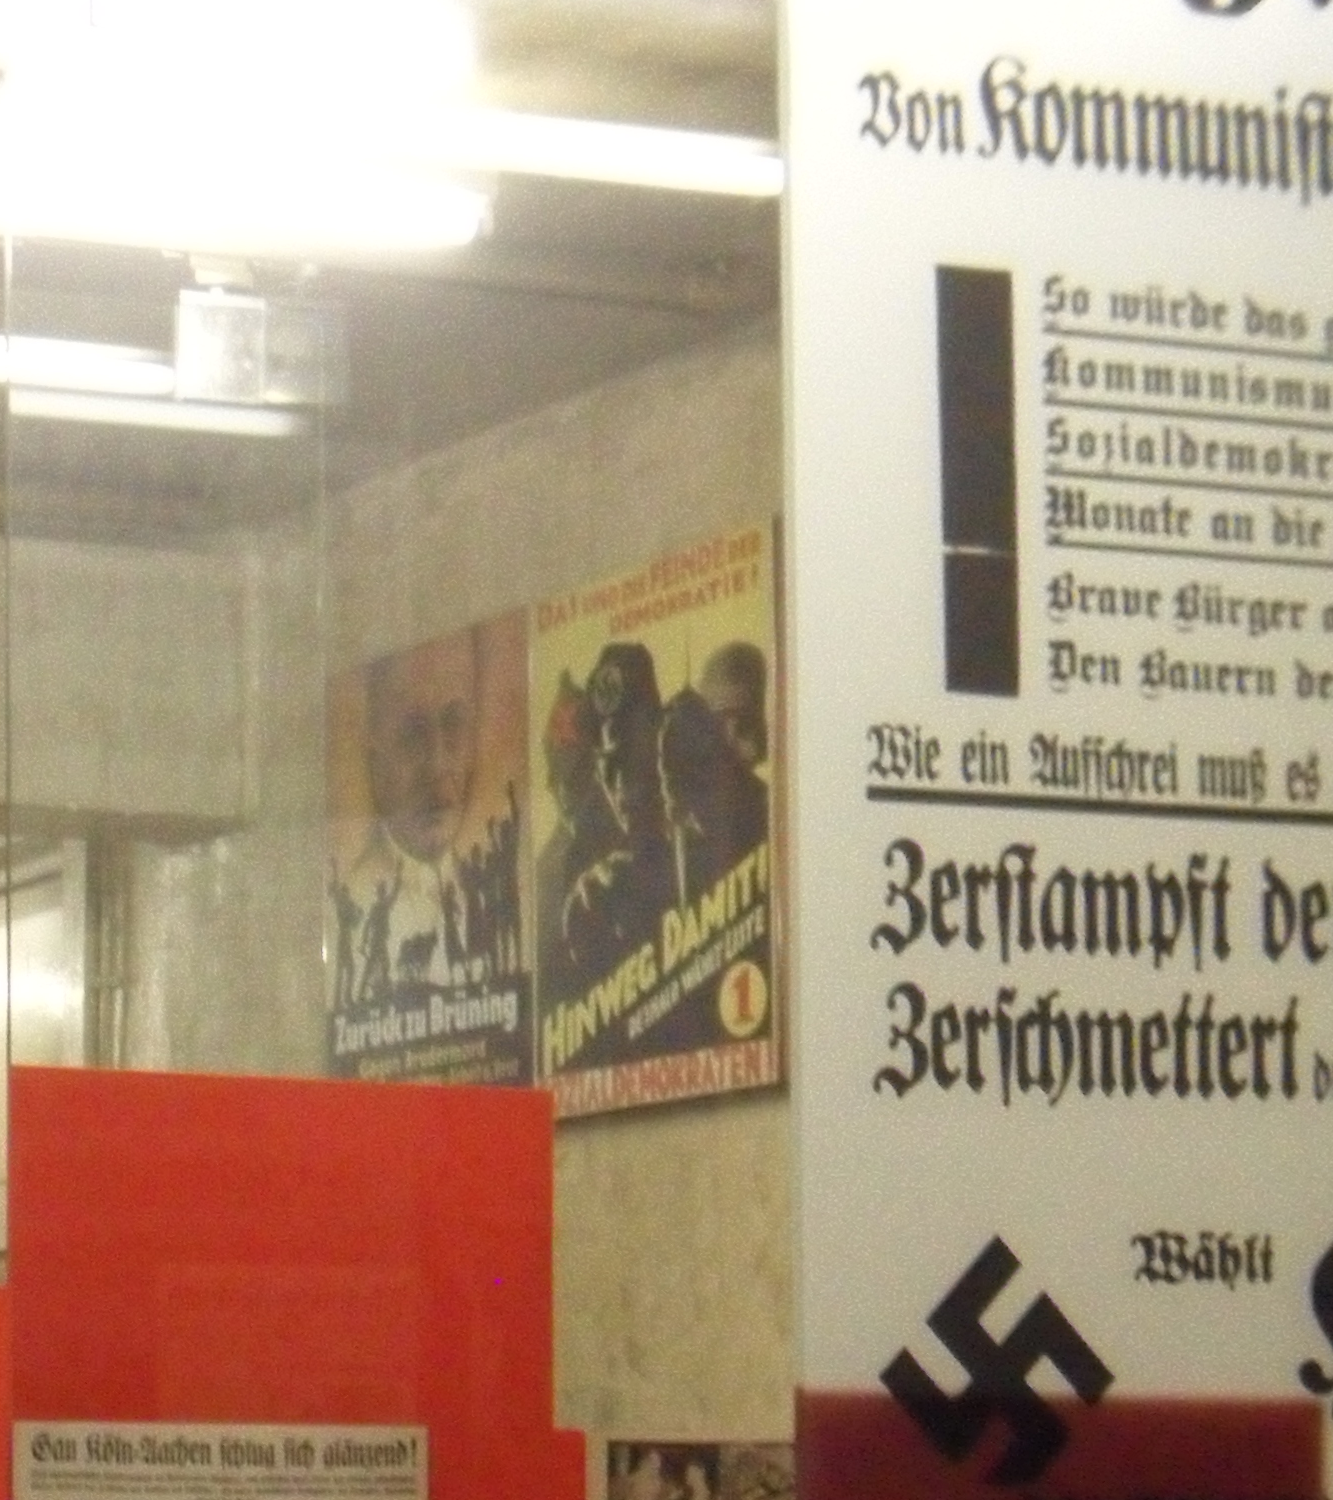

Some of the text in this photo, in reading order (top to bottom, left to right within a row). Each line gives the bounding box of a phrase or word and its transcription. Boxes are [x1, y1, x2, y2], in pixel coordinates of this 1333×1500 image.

[858, 68, 965, 153] Von
[1042, 275, 1308, 341] So würde das
[1045, 485, 1192, 538] Monate
[1210, 510, 1255, 542] an
[1046, 572, 1308, 637] Brave Bürger
[1047, 640, 1122, 691] Den
[1139, 648, 1276, 699] Bauern
[866, 722, 941, 780] Wie
[960, 730, 1010, 786] ein
[1285, 751, 1322, 803] es
[429, 985, 519, 1035] Brüning
[543, 942, 657, 1078] HINWEG
[873, 981, 1299, 1108] Zerschmettert
[1130, 1230, 1274, 1291] Wählt
